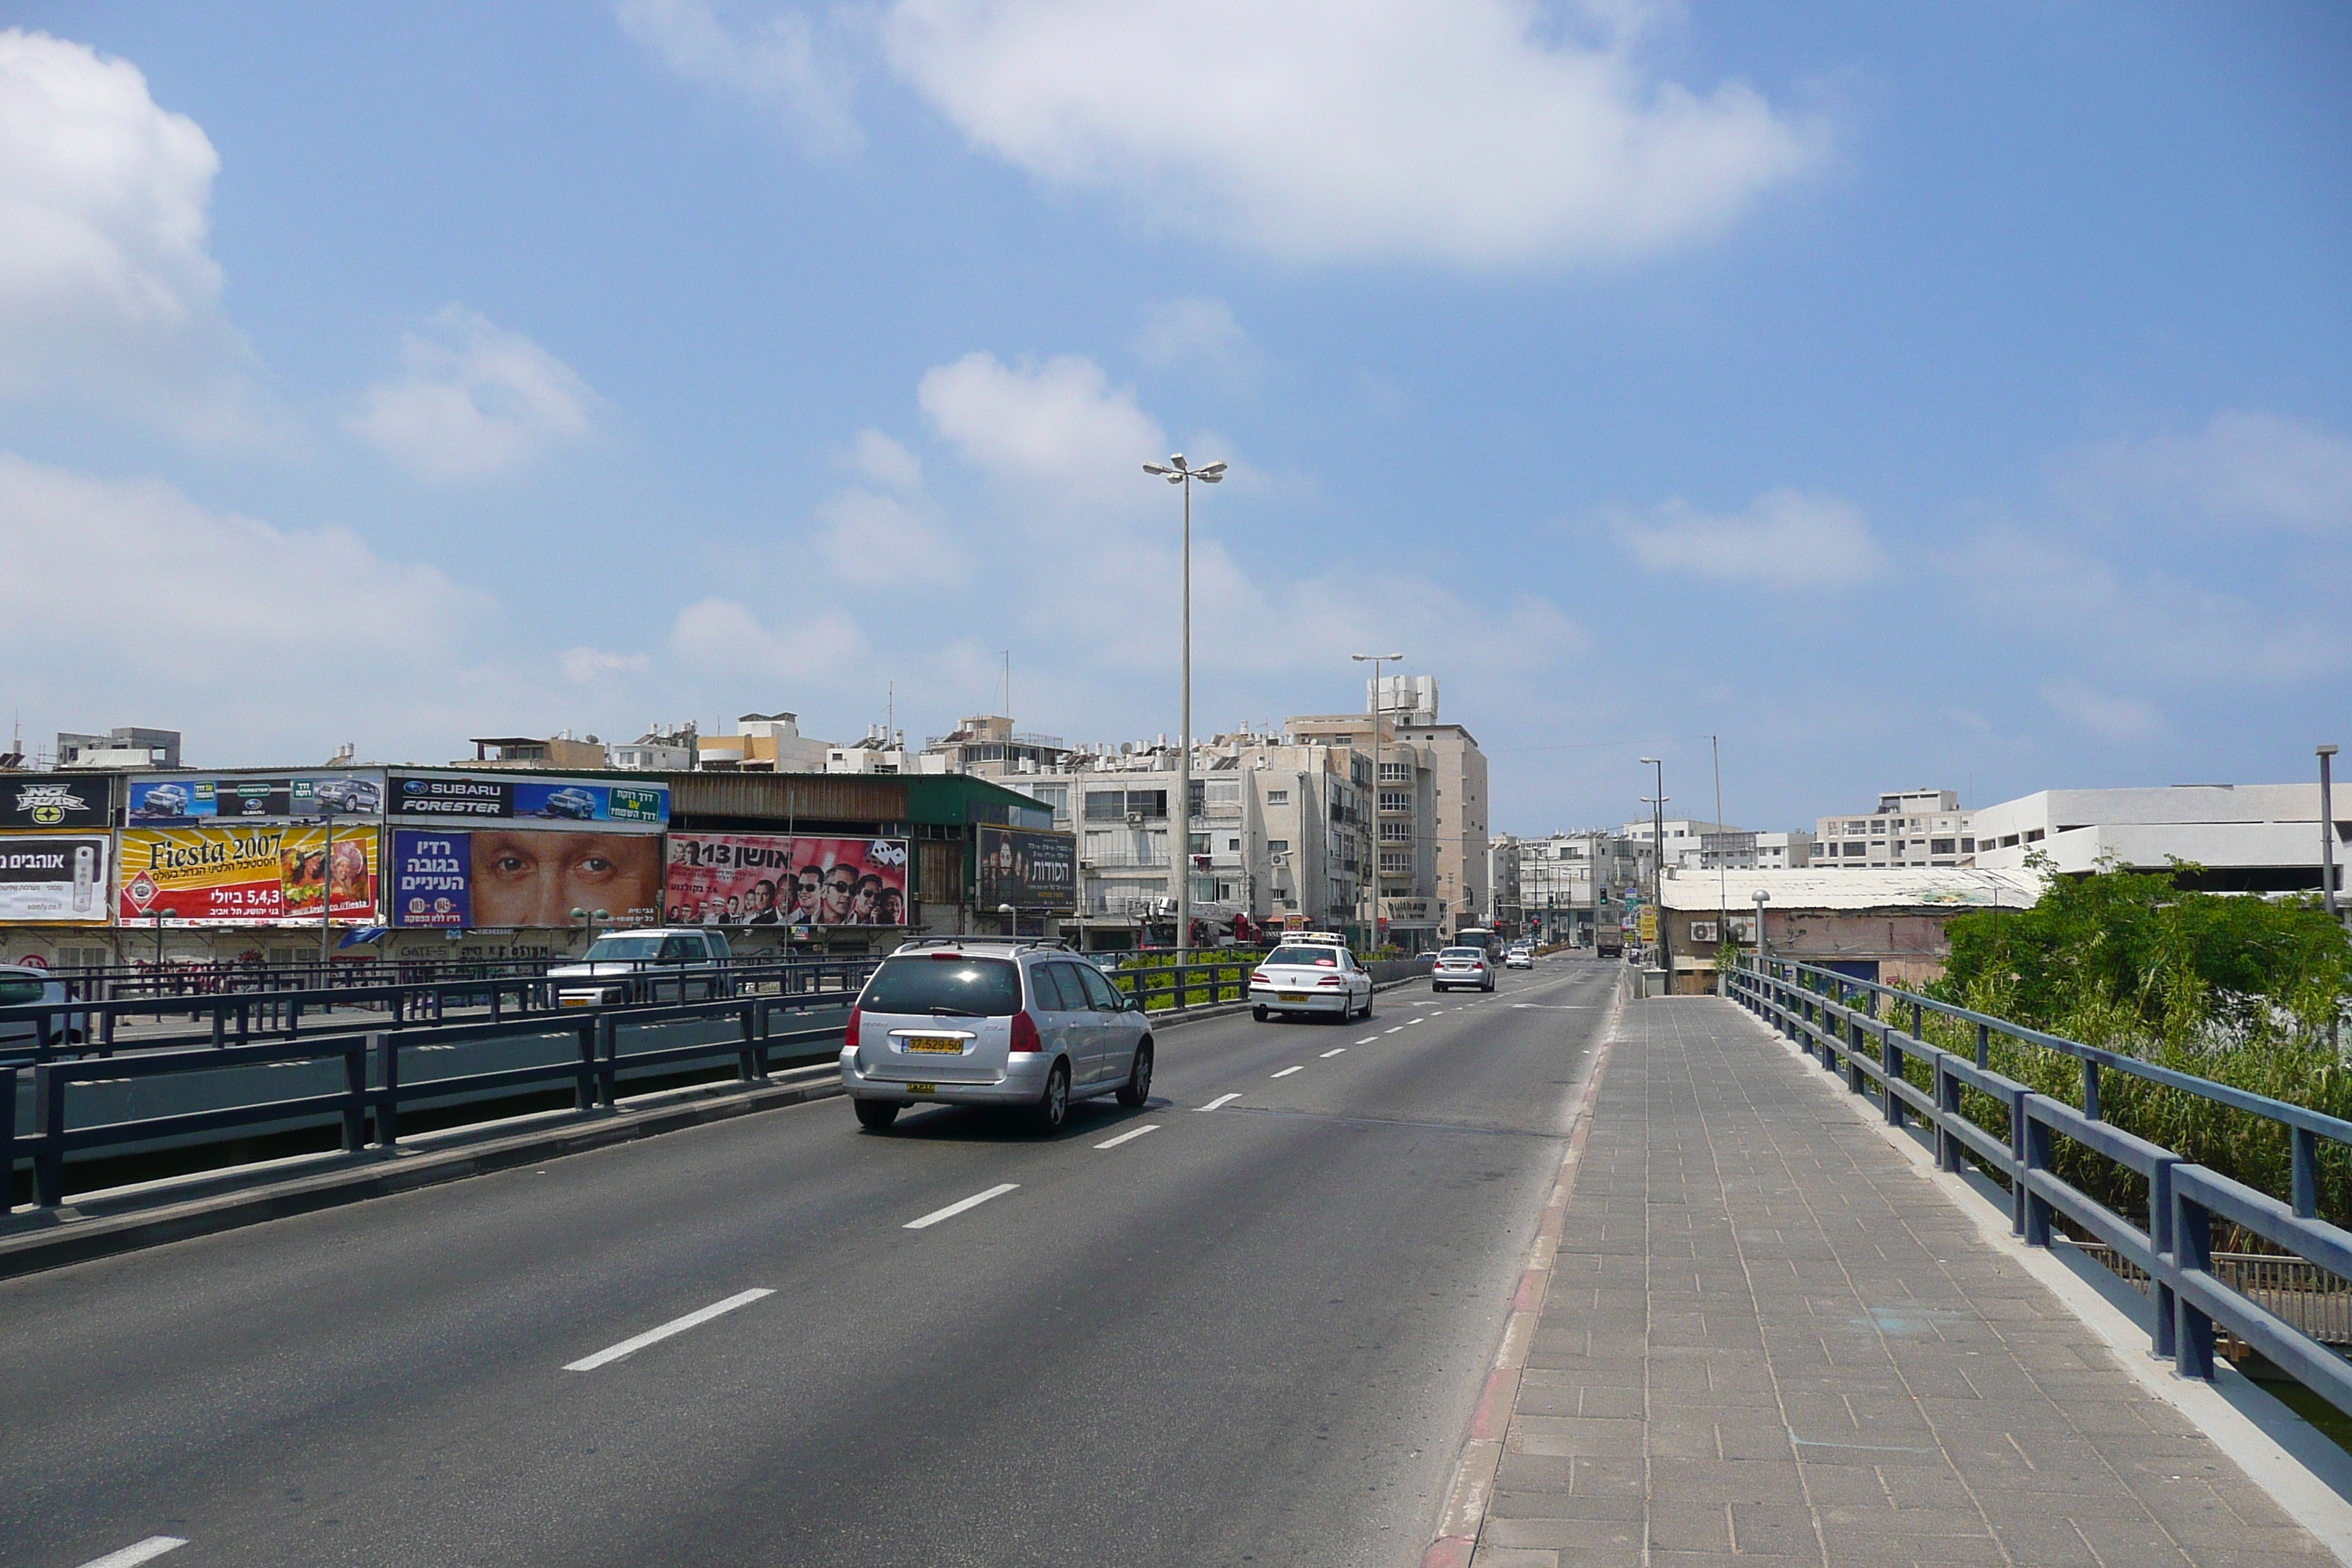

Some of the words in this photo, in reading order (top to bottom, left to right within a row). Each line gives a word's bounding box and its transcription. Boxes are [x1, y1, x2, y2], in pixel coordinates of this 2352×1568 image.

[27, 787, 67, 796] NO
[431, 783, 501, 796] SUBARU
[617, 790, 636, 800] רוקח
[638, 793, 652, 802] דרך
[402, 799, 500, 814] FORESTER
[628, 799, 640, 810] או
[641, 811, 656, 821] דרך
[148, 838, 226, 871] Fiesta
[232, 833, 282, 861] 2007
[417, 841, 451, 855] רדיו
[701, 844, 731, 864] 13
[10, 854, 64, 869] אוהבים
[237, 857, 276, 870] הפסטיבל
[734, 846, 793, 870] אושן
[407, 859, 460, 872] בגובה
[1032, 861, 1068, 882] הסודות
[152, 870, 179, 881] בעולם
[402, 876, 464, 890] העיניים
[670, 883, 704, 894] בקולנוע
[211, 888, 243, 904] ביולי
[209, 908, 229, 916] אביב
[230, 907, 242, 915] תל
